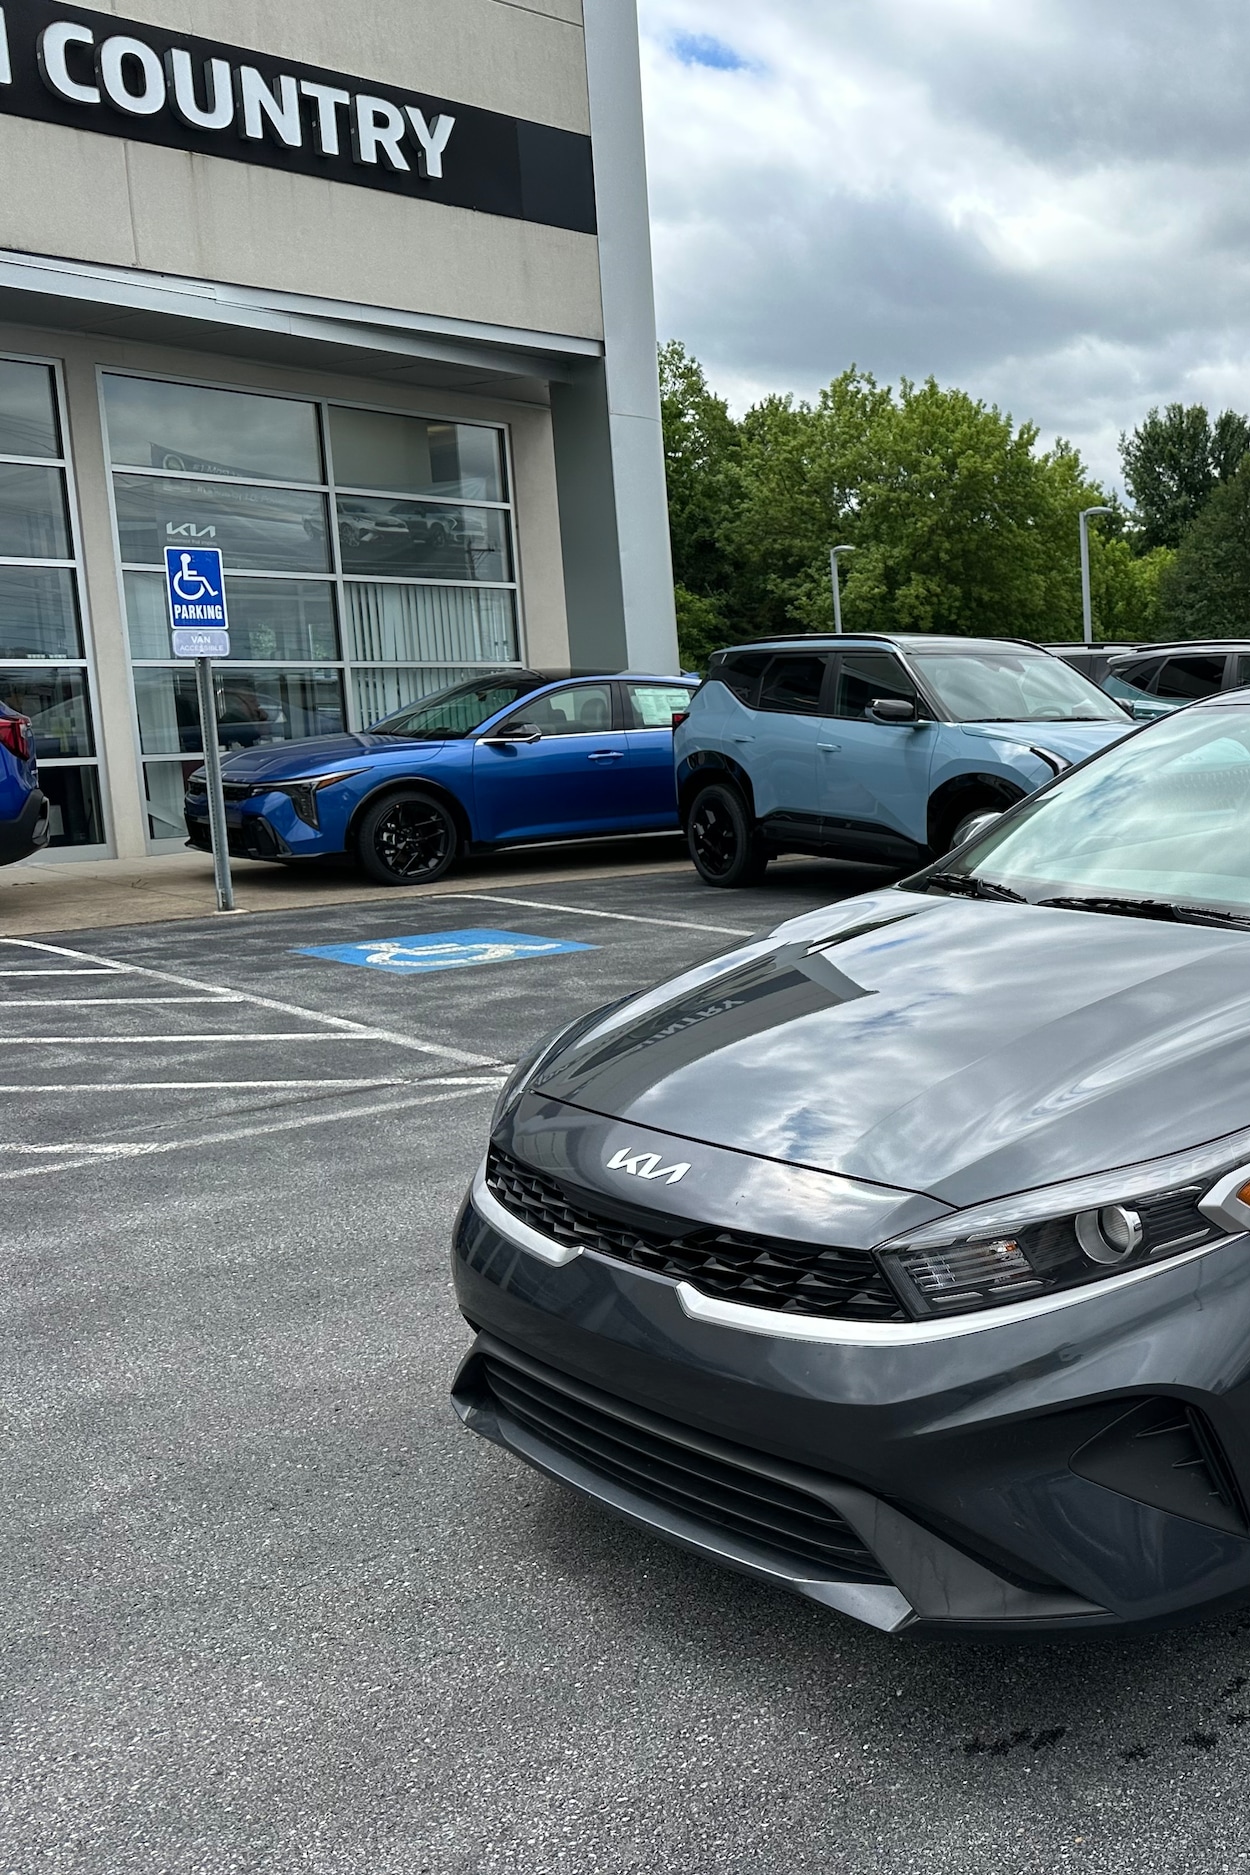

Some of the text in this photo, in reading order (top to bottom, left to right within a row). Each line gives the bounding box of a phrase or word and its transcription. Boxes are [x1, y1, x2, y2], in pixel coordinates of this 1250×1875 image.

[39, 21, 455, 179] COUNTRY
[167, 521, 216, 538] KIA
[174, 604, 223, 620] PARKING
[191, 635, 211, 643] VAN
[179, 644, 224, 652] ACCESSIBLE
[607, 1147, 692, 1186] KIA
